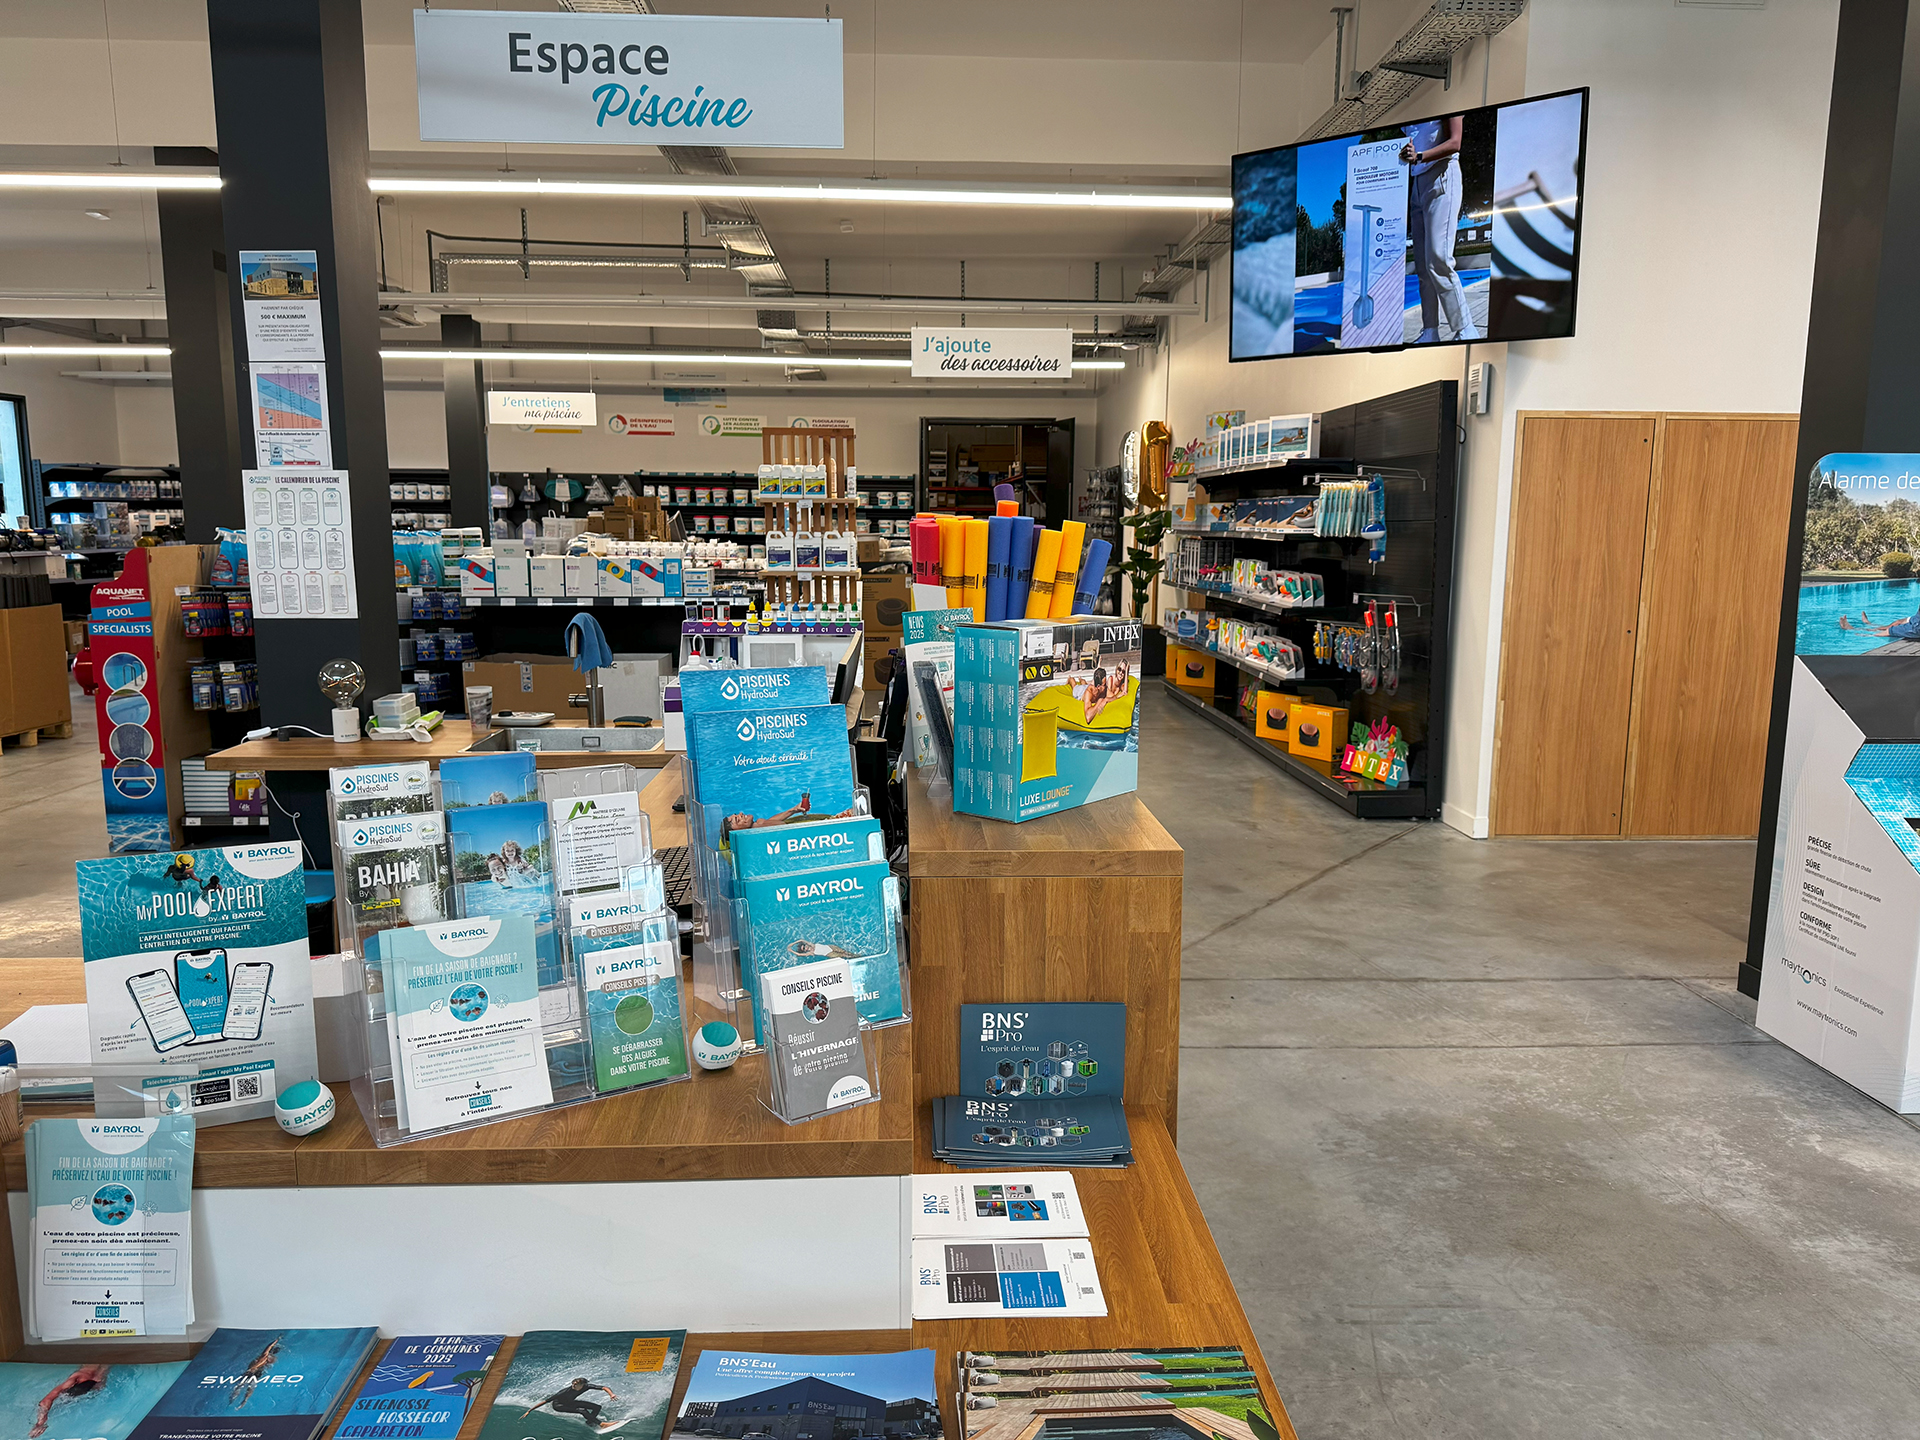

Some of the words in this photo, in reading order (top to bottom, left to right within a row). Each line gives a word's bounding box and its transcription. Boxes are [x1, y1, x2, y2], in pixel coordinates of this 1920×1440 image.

[508, 32, 670, 84] Espace
[592, 83, 753, 128] Piscine
[1352, 147, 1372, 157] APF
[923, 336, 991, 356] J'ajoute
[941, 355, 969, 371] des
[972, 355, 1061, 372] accessoires
[502, 396, 571, 408] J'entretiens
[524, 408, 542, 419] ma
[542, 408, 583, 420] piscine
[1819, 471, 1890, 489] Alarme
[1897, 471, 1920, 490] de
[107, 607, 135, 617] POOL
[908, 615, 924, 630] NEWS
[93, 625, 152, 634] SPECIALISTS
[910, 630, 925, 639] 2025
[1102, 624, 1141, 643] INTEX
[739, 674, 791, 689] PISCINES
[741, 689, 779, 702] HydroSud
[756, 714, 807, 729] PISCINES
[757, 729, 795, 742] HydroSud
[733, 754, 755, 767] Votre
[756, 756, 777, 764] atout
[779, 750, 809, 763] sérénité
[1346, 751, 1403, 782] INTEX
[356, 772, 399, 785] PISCINES
[357, 784, 389, 793] HydroSud
[1020, 793, 1040, 807] LUXE
[369, 823, 413, 836] PISCINES
[370, 835, 402, 845] HydroSud
[787, 833, 854, 853] BAYROL
[1808, 836, 1832, 851] PRÉCISE
[248, 847, 295, 858] BAYROL
[1805, 858, 1821, 871] SÛRE
[358, 860, 421, 888] BAHIA
[359, 890, 369, 898] By
[797, 877, 864, 899] BAYROL
[1803, 882, 1825, 897] DESIGN
[208, 884, 265, 913] EXPERT
[232, 910, 267, 920] BAYROL
[597, 904, 646, 919] BAYROL
[1800, 911, 1832, 932] CONFORME
[139, 934, 163, 943] L'APPLI
[165, 929, 209, 940] INTELLIGENTE
[224, 924, 251, 932] FACILITE
[140, 939, 181, 949] L'ENTRETIEN
[611, 957, 662, 972] BAYROL
[605, 980, 632, 992] CONSEILS
[781, 979, 815, 996] CONSEILS
[817, 973, 843, 988] PISCINE
[1781, 957, 1827, 987] maytronics
[1834, 986, 1859, 1003] Exceptional
[1860, 999, 1884, 1016] Experience
[982, 1012, 1030, 1029] BNS'
[1797, 999, 1858, 1038] www.maytronics.com
[995, 1029, 1023, 1042] Pro
[613, 1046, 620, 1055] SE
[621, 1038, 663, 1053] DÉBARRASSER
[981, 1045, 1009, 1053] L'esprit
[1011, 1045, 1021, 1053] de
[1022, 1045, 1040, 1053] l'eau
[621, 1054, 633, 1063] DES
[634, 1049, 657, 1061] ALGUES
[610, 1065, 628, 1076] DANS
[628, 1061, 647, 1072] VOTRE
[648, 1056, 670, 1068] PISCINE
[840, 1085, 866, 1097] BAYROL
[59, 1157, 70, 1168] FIN
[72, 1157, 80, 1168] DE
[83, 1157, 91, 1168] LA
[93, 1157, 118, 1168] SAISON
[121, 1157, 129, 1168] DE
[131, 1157, 166, 1168] BAIGNADE
[52, 1168, 89, 1181] PRÉSERVEZ
[91, 1170, 110, 1181] L'EAU
[113, 1170, 121, 1181] DE
[123, 1170, 144, 1181] VOTRE
[147, 1170, 172, 1181] PISCINE
[434, 1337, 464, 1345] PLAN
[405, 1345, 420, 1354] DE
[422, 1344, 482, 1354] COMMUNES
[423, 1355, 453, 1364] 2025
[720, 1358, 776, 1369] BNS'Eau
[200, 1375, 304, 1385] SWIMEO
[356, 1398, 435, 1411] SEIGNOSSE
[377, 1412, 451, 1424] HOSSEGOR
[342, 1425, 425, 1438] CAPBRETON
